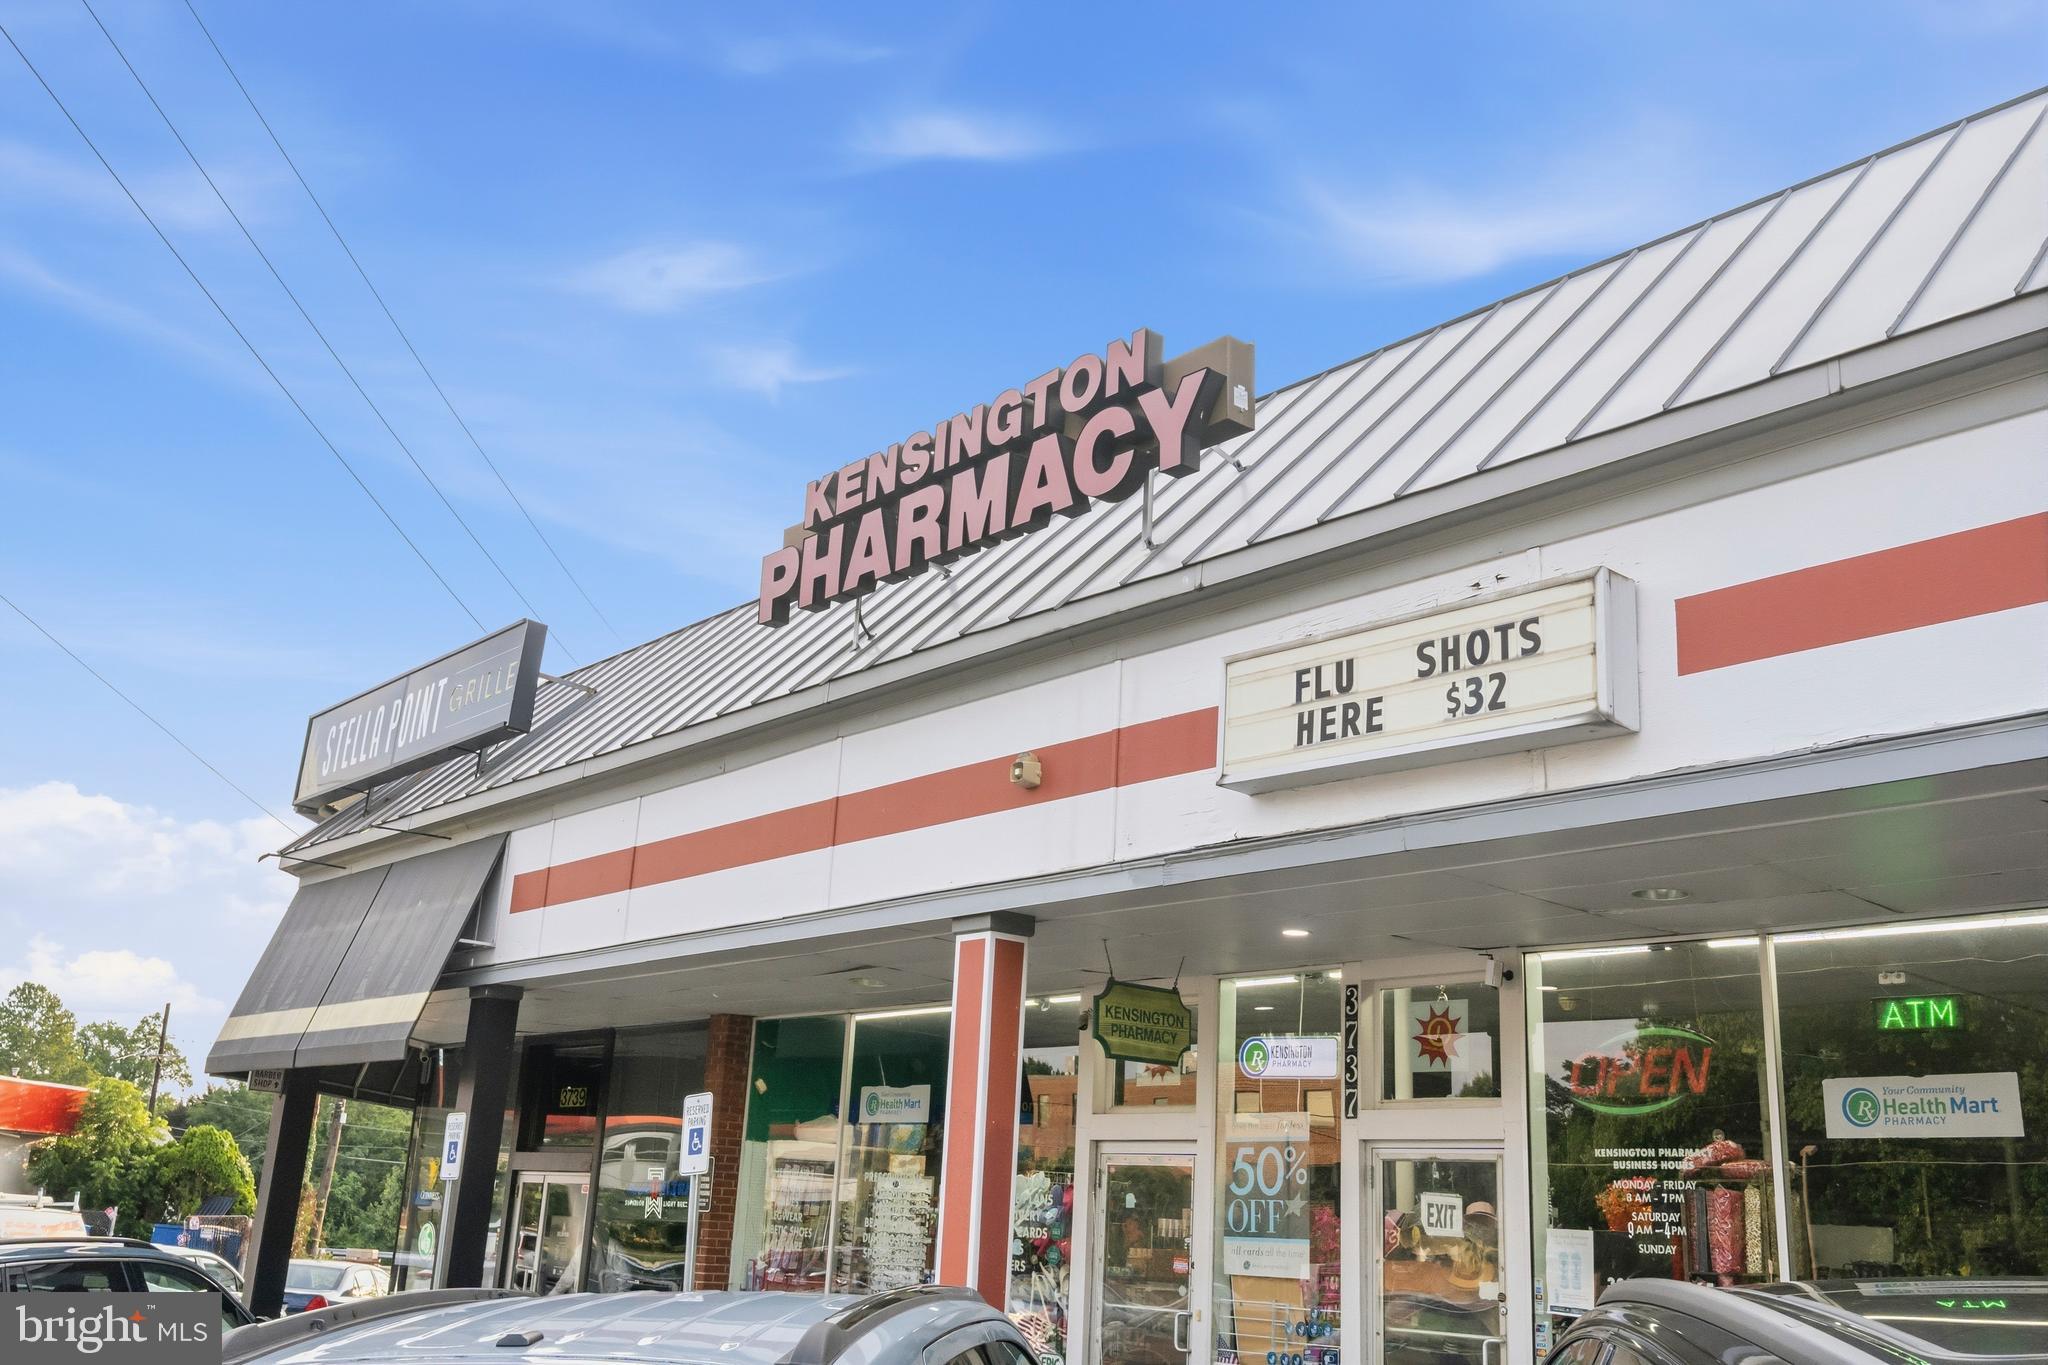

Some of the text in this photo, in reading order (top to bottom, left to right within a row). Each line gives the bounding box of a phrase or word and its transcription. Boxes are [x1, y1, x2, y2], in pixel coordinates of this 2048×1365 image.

[803, 328, 1149, 531] KENSINGTON
[758, 367, 1209, 626] PHARMACY
[1295, 616, 1542, 705] FLU SHOTS
[322, 660, 520, 777] STELLA POINT GRILLE
[1296, 671, 1507, 748] HERE $32
[1105, 1004, 1184, 1029] KENSINGTON
[1883, 999, 1954, 1029] ATM
[1111, 1023, 1178, 1045] PHARMACY
[1270, 1045, 1313, 1060] KENSINGTON
[1346, 987, 1358, 1118] 3737
[1272, 1060, 1312, 1068] PHARMACY
[1570, 1046, 1713, 1097] OPEN
[561, 1089, 586, 1106] 3739
[1882, 1085, 1966, 1095] Your Community
[880, 1098, 904, 1110] Health
[903, 1098, 921, 1109] Mart
[1883, 1097, 1947, 1116] Health
[1951, 1096, 1999, 1114] Mart
[1884, 1116, 1947, 1126] PHARMACY
[1594, 1148, 1713, 1158] KENSINGTON PHARMACY
[1229, 1146, 1308, 1197] 50%
[1613, 1160, 1695, 1170] BUSINESS HOURS
[1612, 1180, 1656, 1190] MONDAY
[1663, 1180, 1697, 1190] FRIDAY
[1227, 1198, 1285, 1234] OFF
[1426, 1202, 1457, 1230] EXIT
[1631, 1211, 1681, 1223] SATURDAY
[1638, 1243, 1678, 1255] SUNDAY
